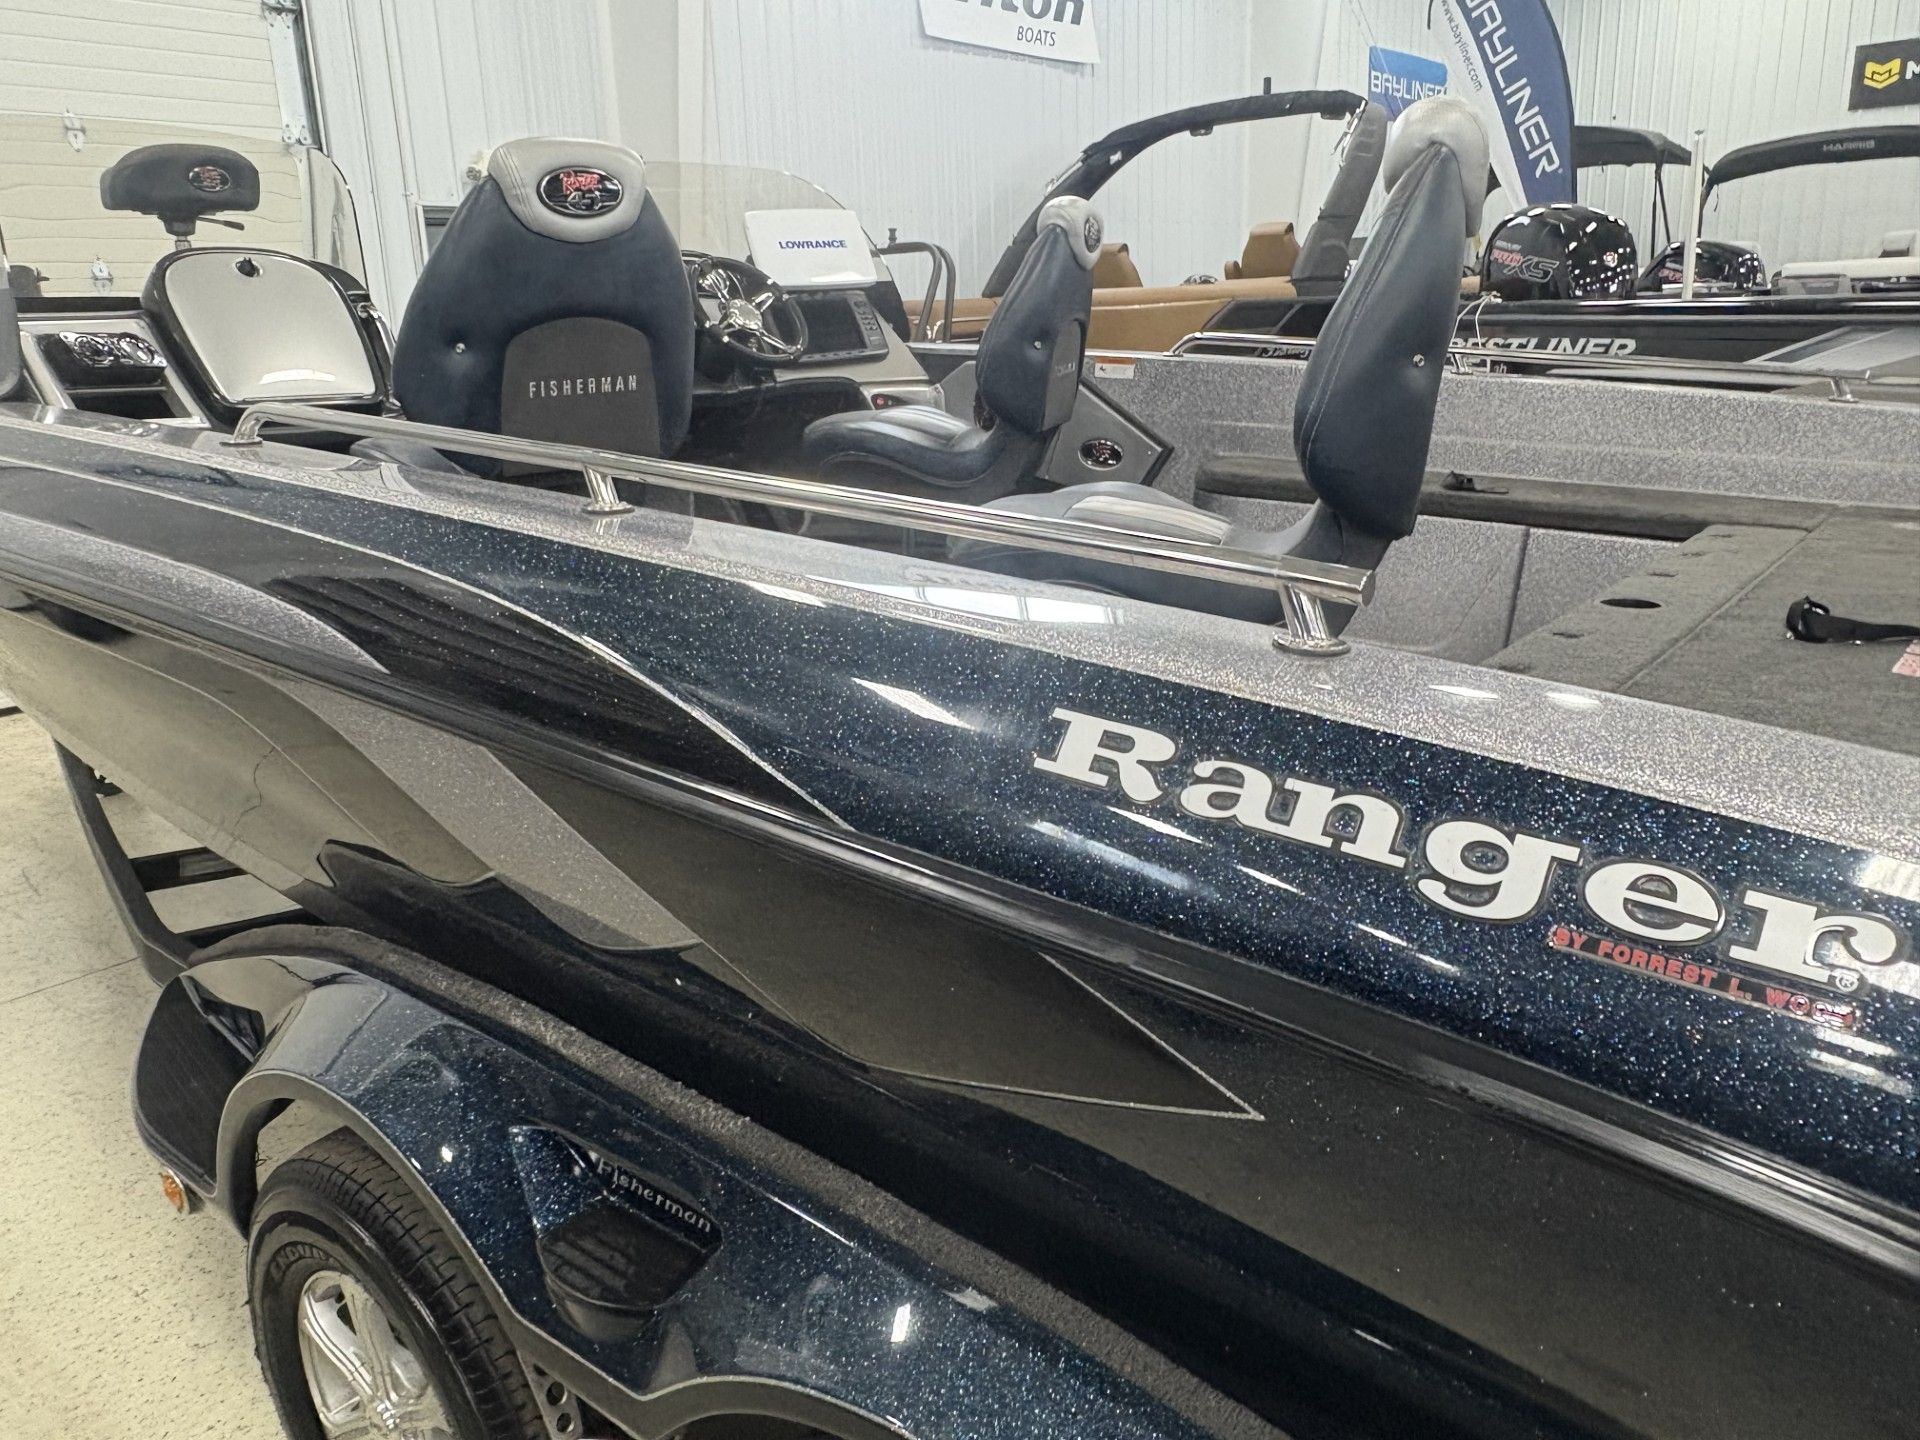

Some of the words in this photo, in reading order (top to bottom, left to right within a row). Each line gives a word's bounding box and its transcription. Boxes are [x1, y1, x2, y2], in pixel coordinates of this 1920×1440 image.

[1017, 26, 1056, 47] BOATS
[778, 239, 847, 250] LOWRANCE
[528, 375, 638, 399] FISHERMAN
[1033, 707, 1900, 984] Ranger
[1551, 926, 1590, 950] BY
[1597, 939, 1719, 987] FORREST
[1765, 986, 1857, 1029] WO
[597, 1157, 712, 1233] Fisherman
